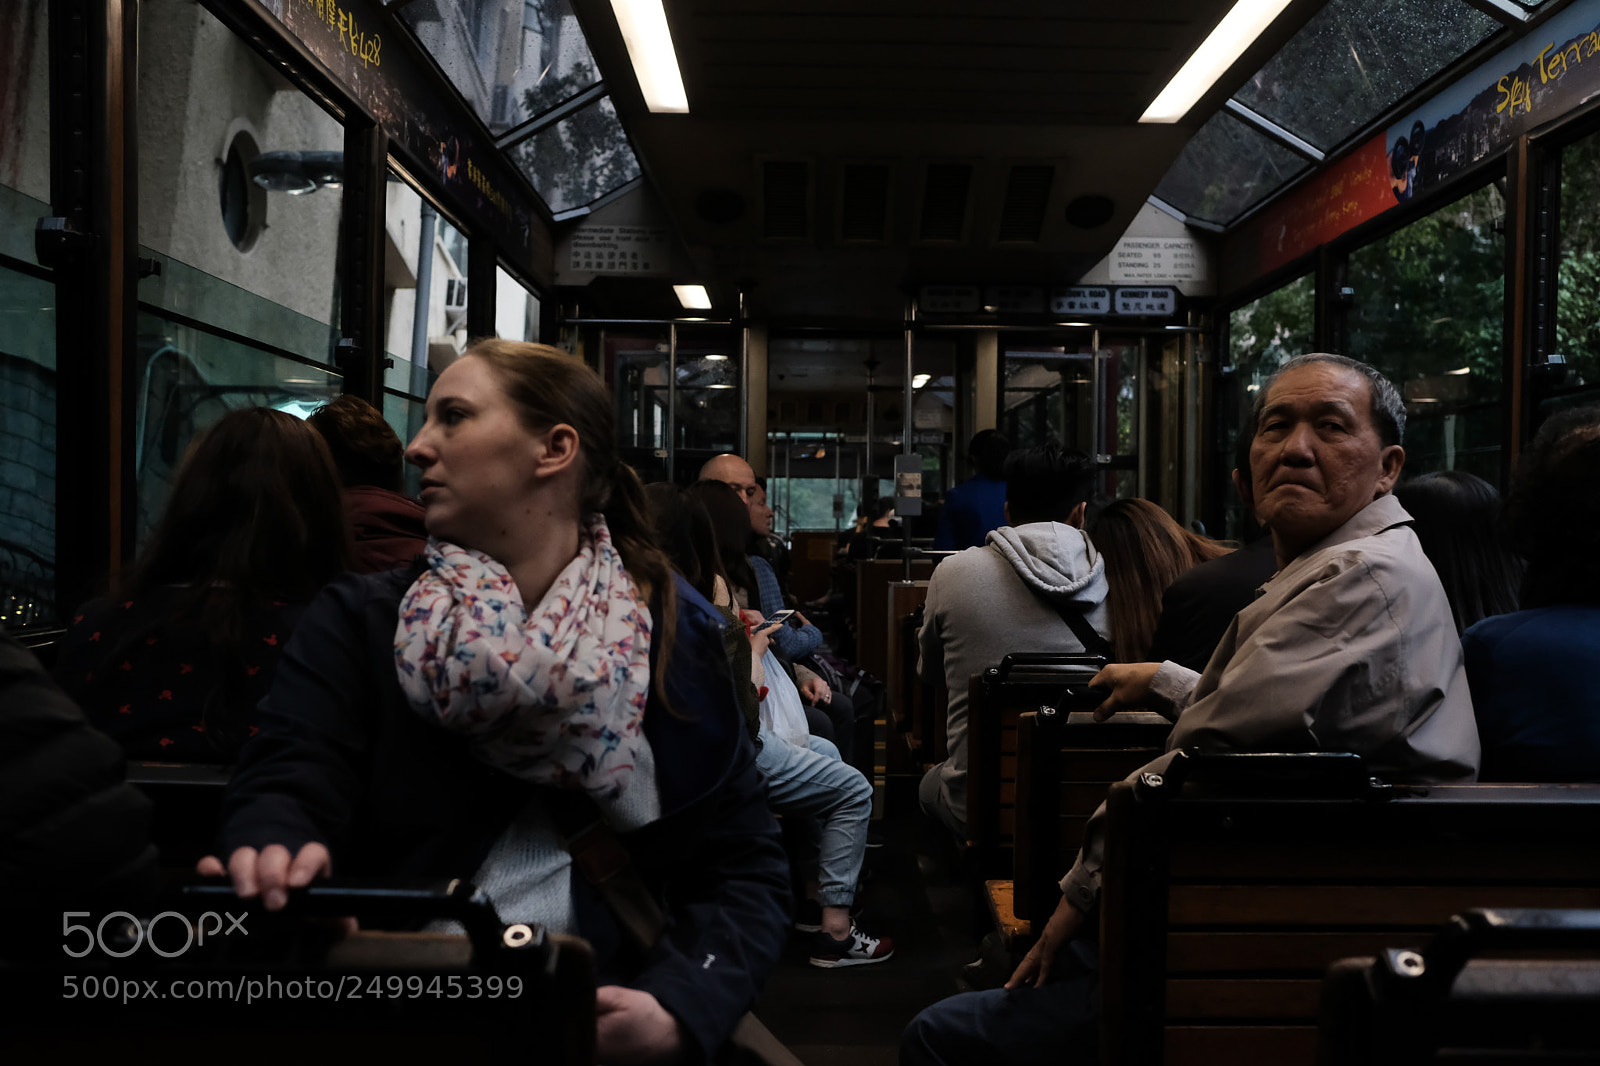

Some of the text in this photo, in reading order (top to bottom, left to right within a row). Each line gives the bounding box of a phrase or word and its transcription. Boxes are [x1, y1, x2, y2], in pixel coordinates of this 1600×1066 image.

[1496, 70, 1531, 118] Sky
[1164, 242, 1194, 250] CAPACITY
[1089, 290, 1106, 298] ROAD
